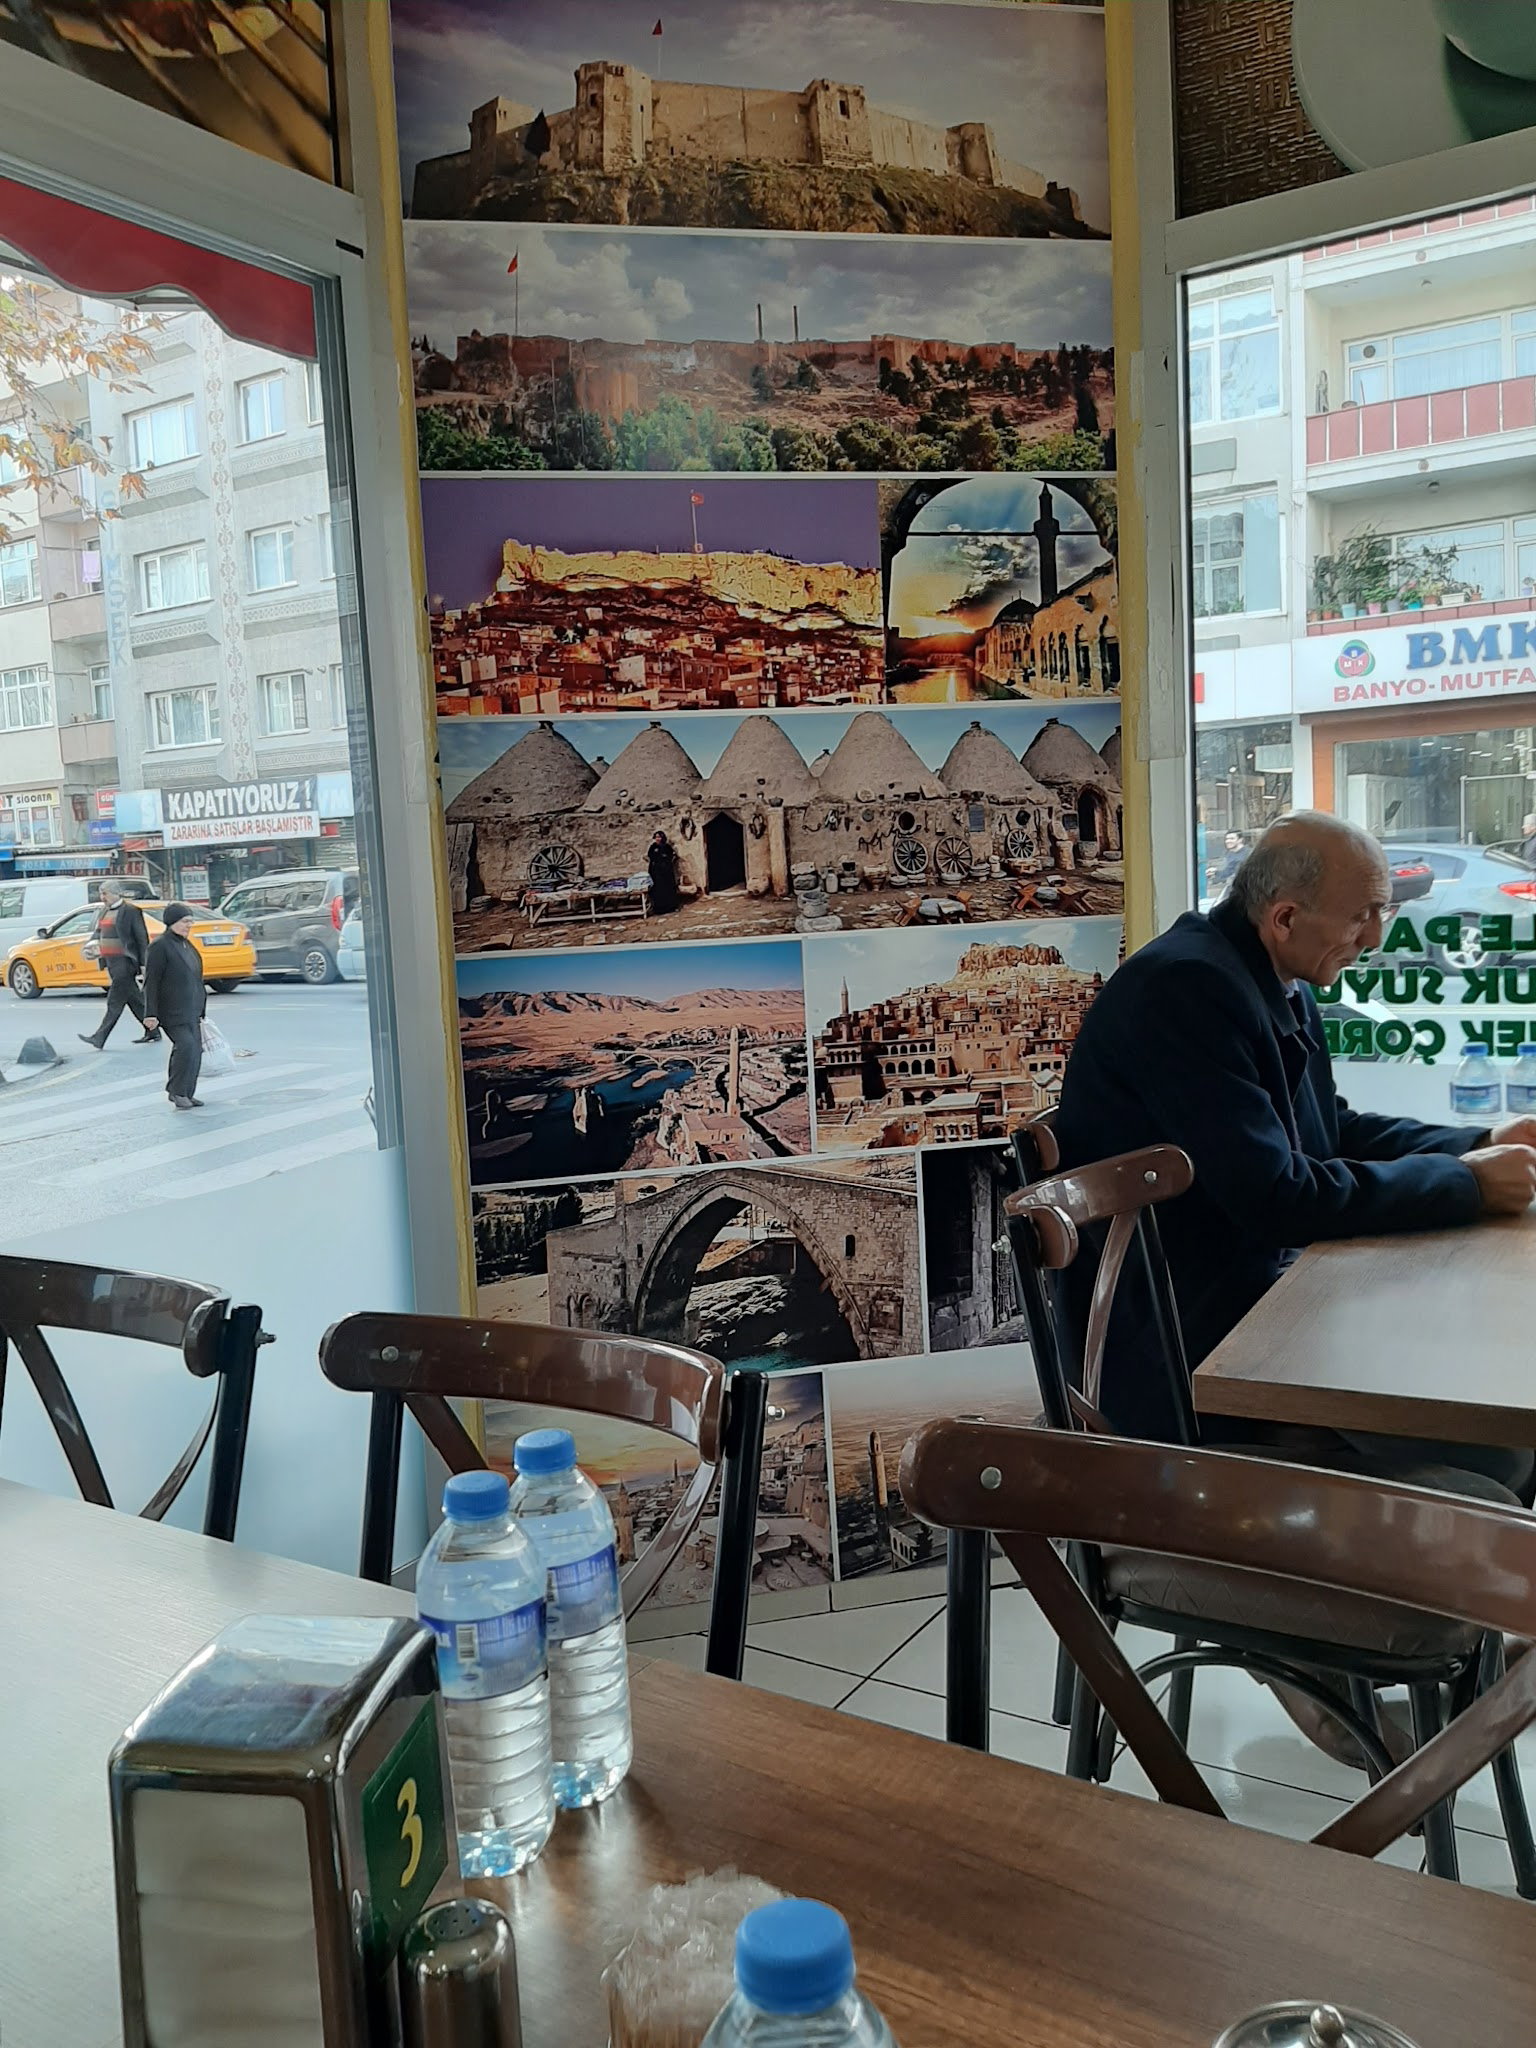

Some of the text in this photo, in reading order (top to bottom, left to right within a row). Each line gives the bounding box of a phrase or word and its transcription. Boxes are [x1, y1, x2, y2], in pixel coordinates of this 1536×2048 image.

[171, 815, 314, 840] ZARARINA SATIŞLAR BAŞLAMIŞTIR
[396, 1777, 423, 1888] 3
